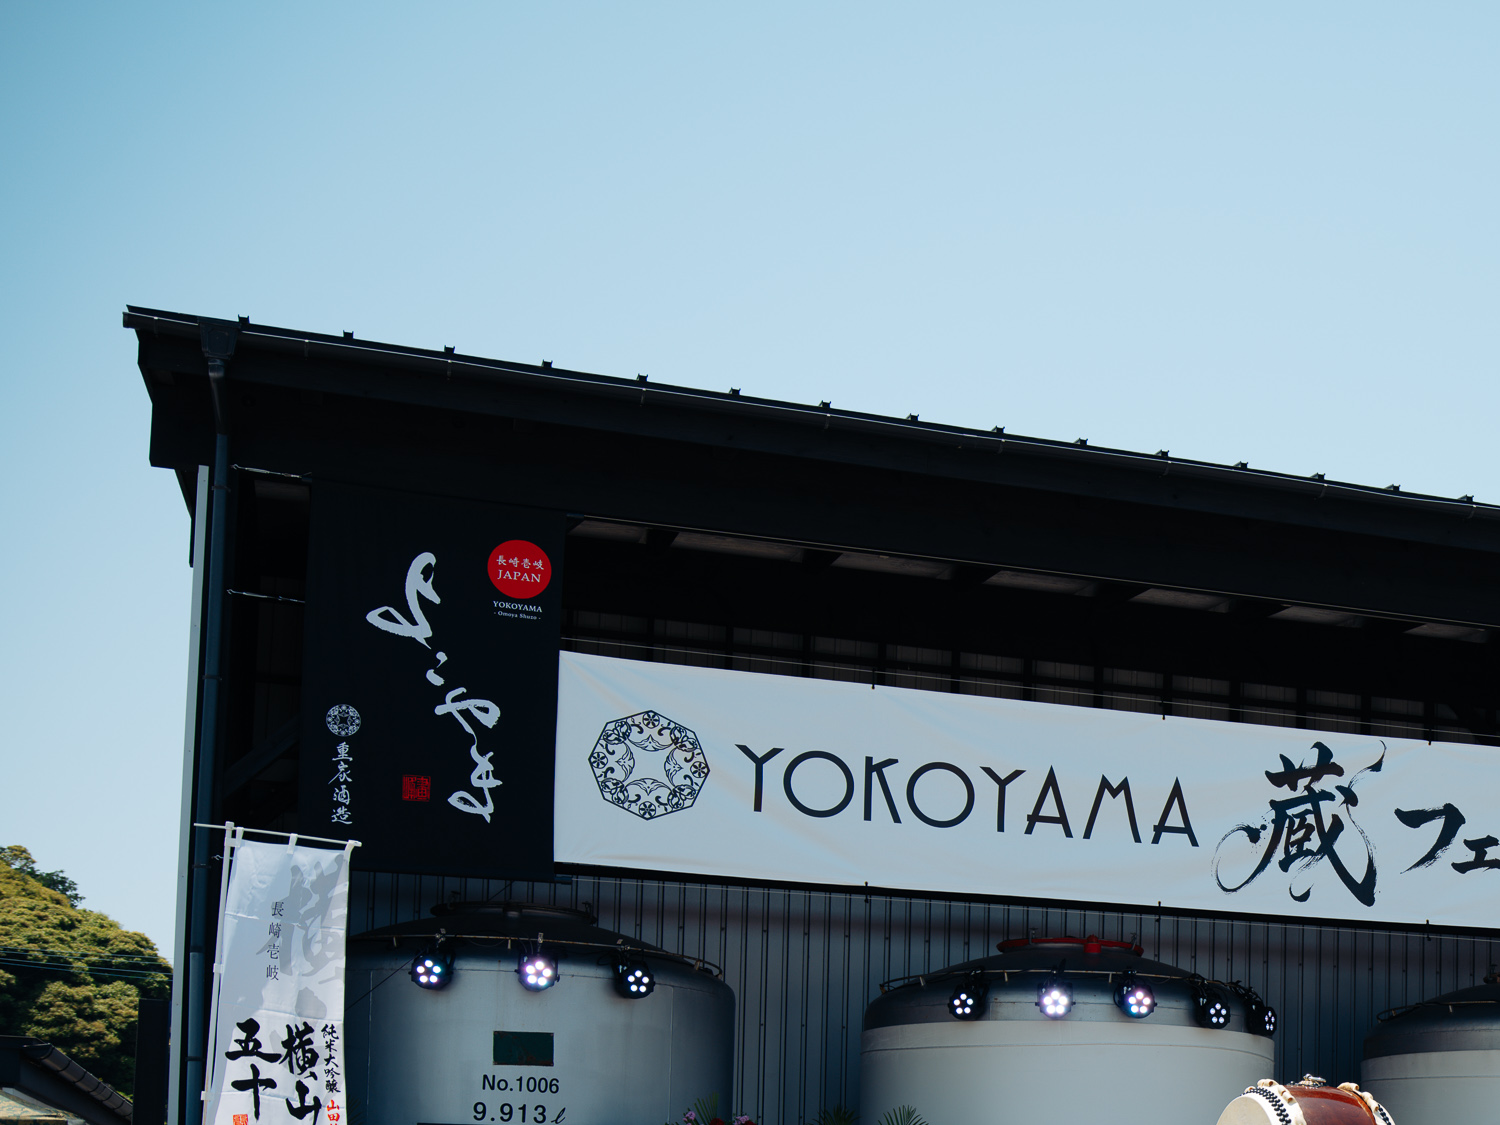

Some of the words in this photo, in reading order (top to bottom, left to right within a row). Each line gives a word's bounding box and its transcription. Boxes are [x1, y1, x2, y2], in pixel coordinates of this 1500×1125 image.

[493, 600, 543, 613] YOKOYAMA
[497, 570, 541, 583] JAPAN
[328, 742, 354, 825] 重家酒造
[734, 743, 1200, 848] YOKOYAMA
[265, 901, 284, 982] 長崎壱岐
[225, 1018, 282, 1121] 五十
[482, 1074, 560, 1094] No.1006
